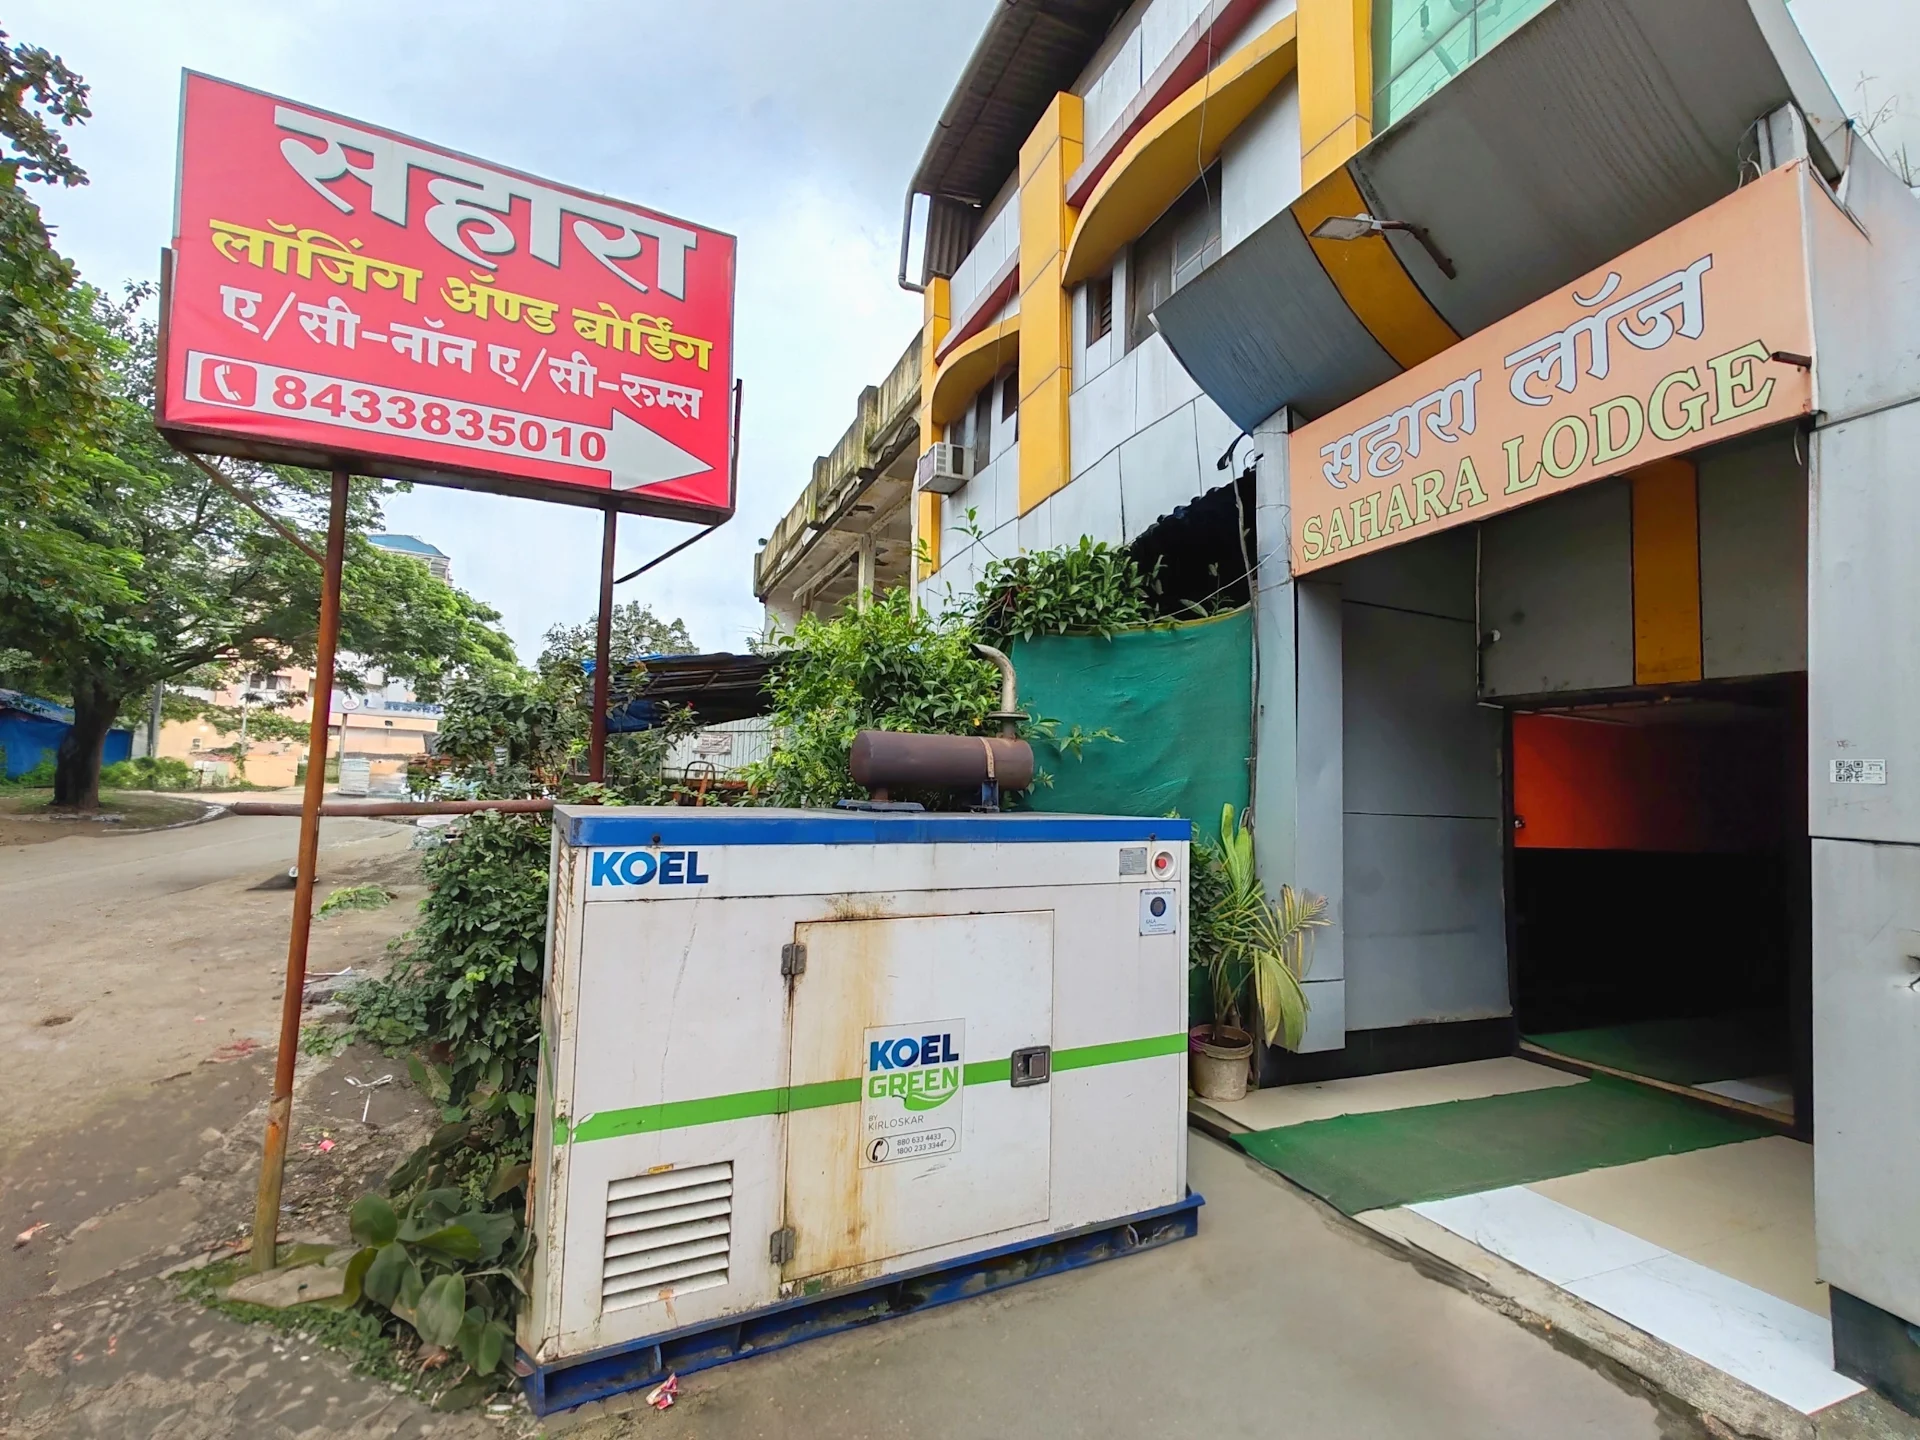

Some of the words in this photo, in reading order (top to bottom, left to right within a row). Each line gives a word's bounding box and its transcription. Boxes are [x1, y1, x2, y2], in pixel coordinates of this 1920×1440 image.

[274, 104, 697, 301] सहारा
[209, 218, 424, 304] लॉजिंग
[572, 301, 714, 371] बोर्डिंग
[1320, 368, 1482, 490] सहारा
[1504, 252, 1713, 406] लॉज
[271, 374, 607, 463] 8433835010
[1302, 456, 1489, 563] SAHARA
[1502, 339, 1777, 496] LODGE
[591, 851, 709, 886] KOEL
[869, 1033, 959, 1071] KOEL
[868, 1065, 960, 1099] GREEN
[868, 1114, 924, 1131] KIRLOSKAR
[897, 1138, 910, 1146] 880
[912, 1136, 924, 1144] 633
[926, 1133, 941, 1141] 4433
[897, 1146, 912, 1154] 1800
[914, 1144, 926, 1152] 233
